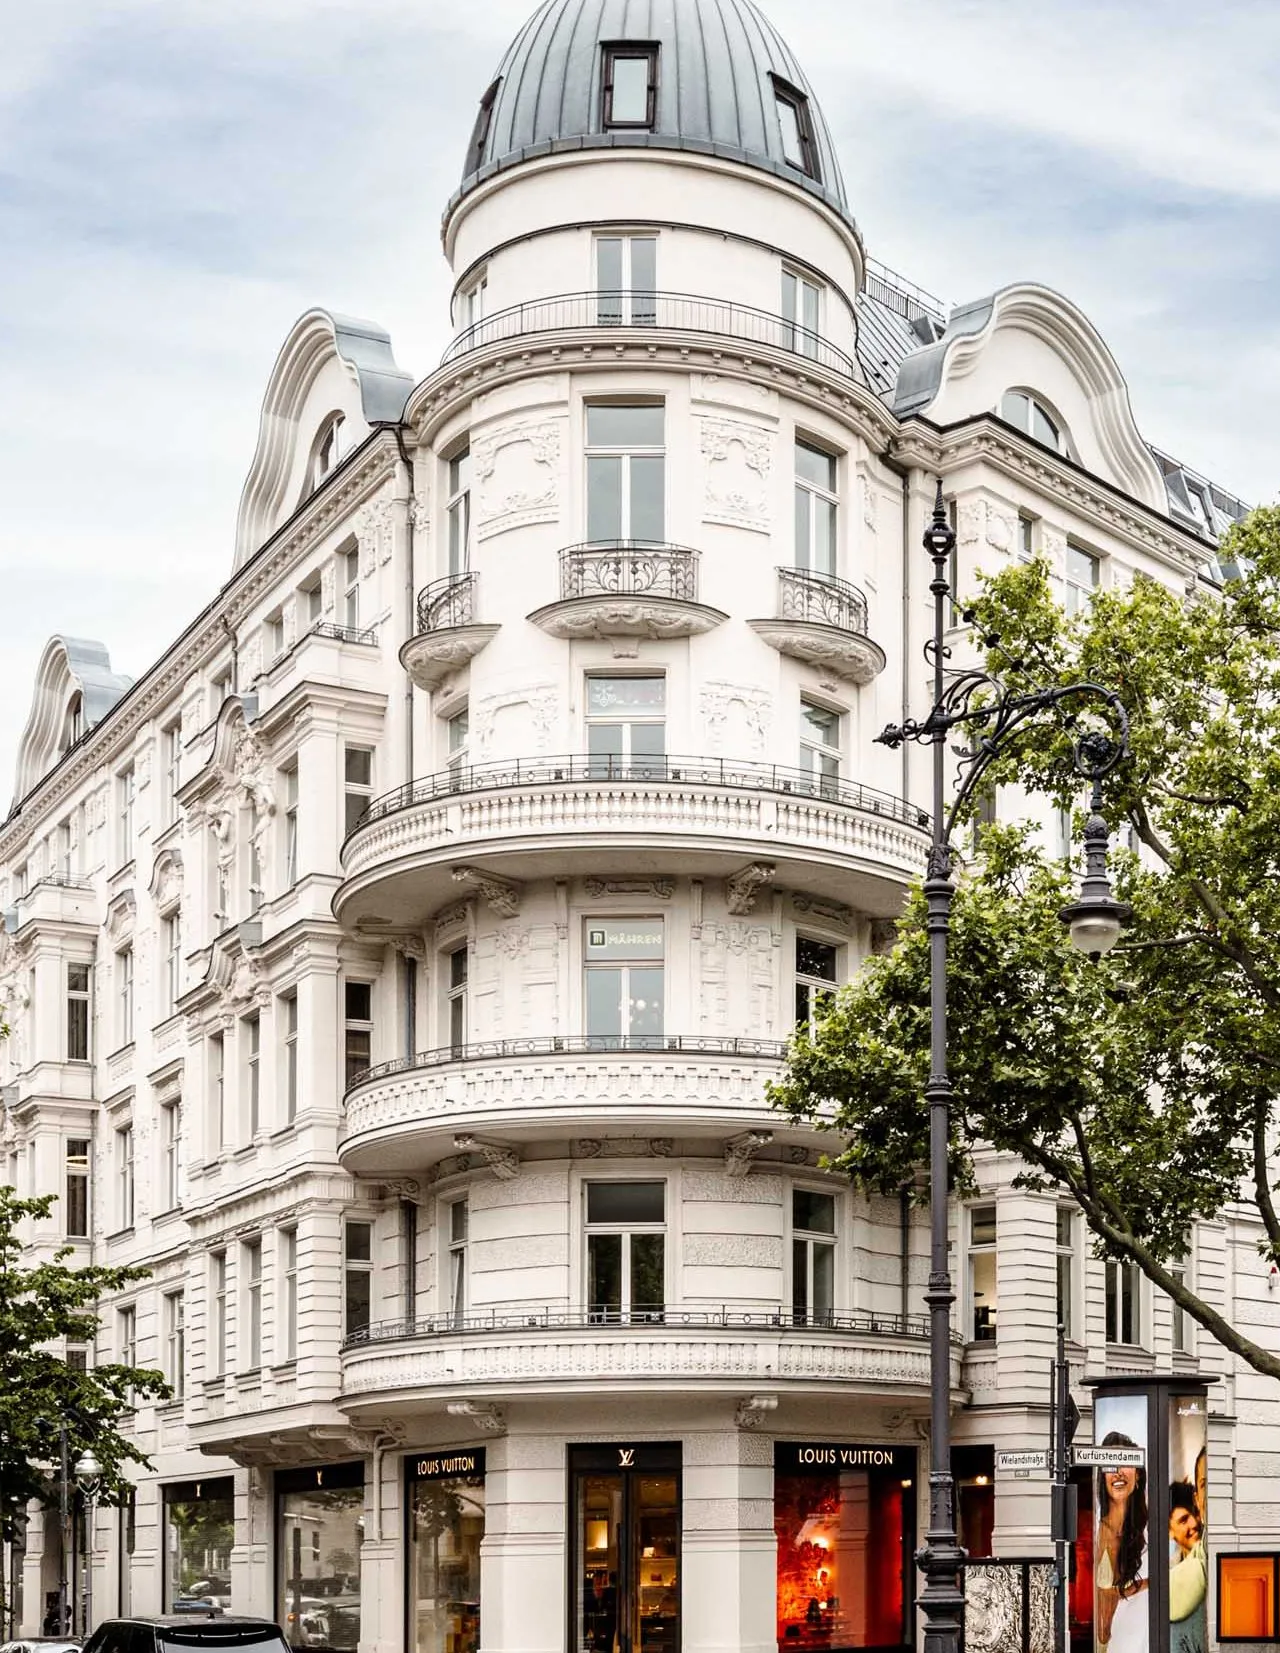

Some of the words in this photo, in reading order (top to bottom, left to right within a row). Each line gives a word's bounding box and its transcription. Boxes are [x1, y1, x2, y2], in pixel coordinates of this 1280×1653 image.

[799, 1448, 836, 1464] LOUIS
[841, 1450, 893, 1465] VUITTON
[1001, 1454, 1044, 1466] Wielandstraße
[1076, 1449, 1141, 1461] Kurfürstendamm
[417, 1460, 439, 1475] LOUIS
[441, 1456, 475, 1473] VUITTON
